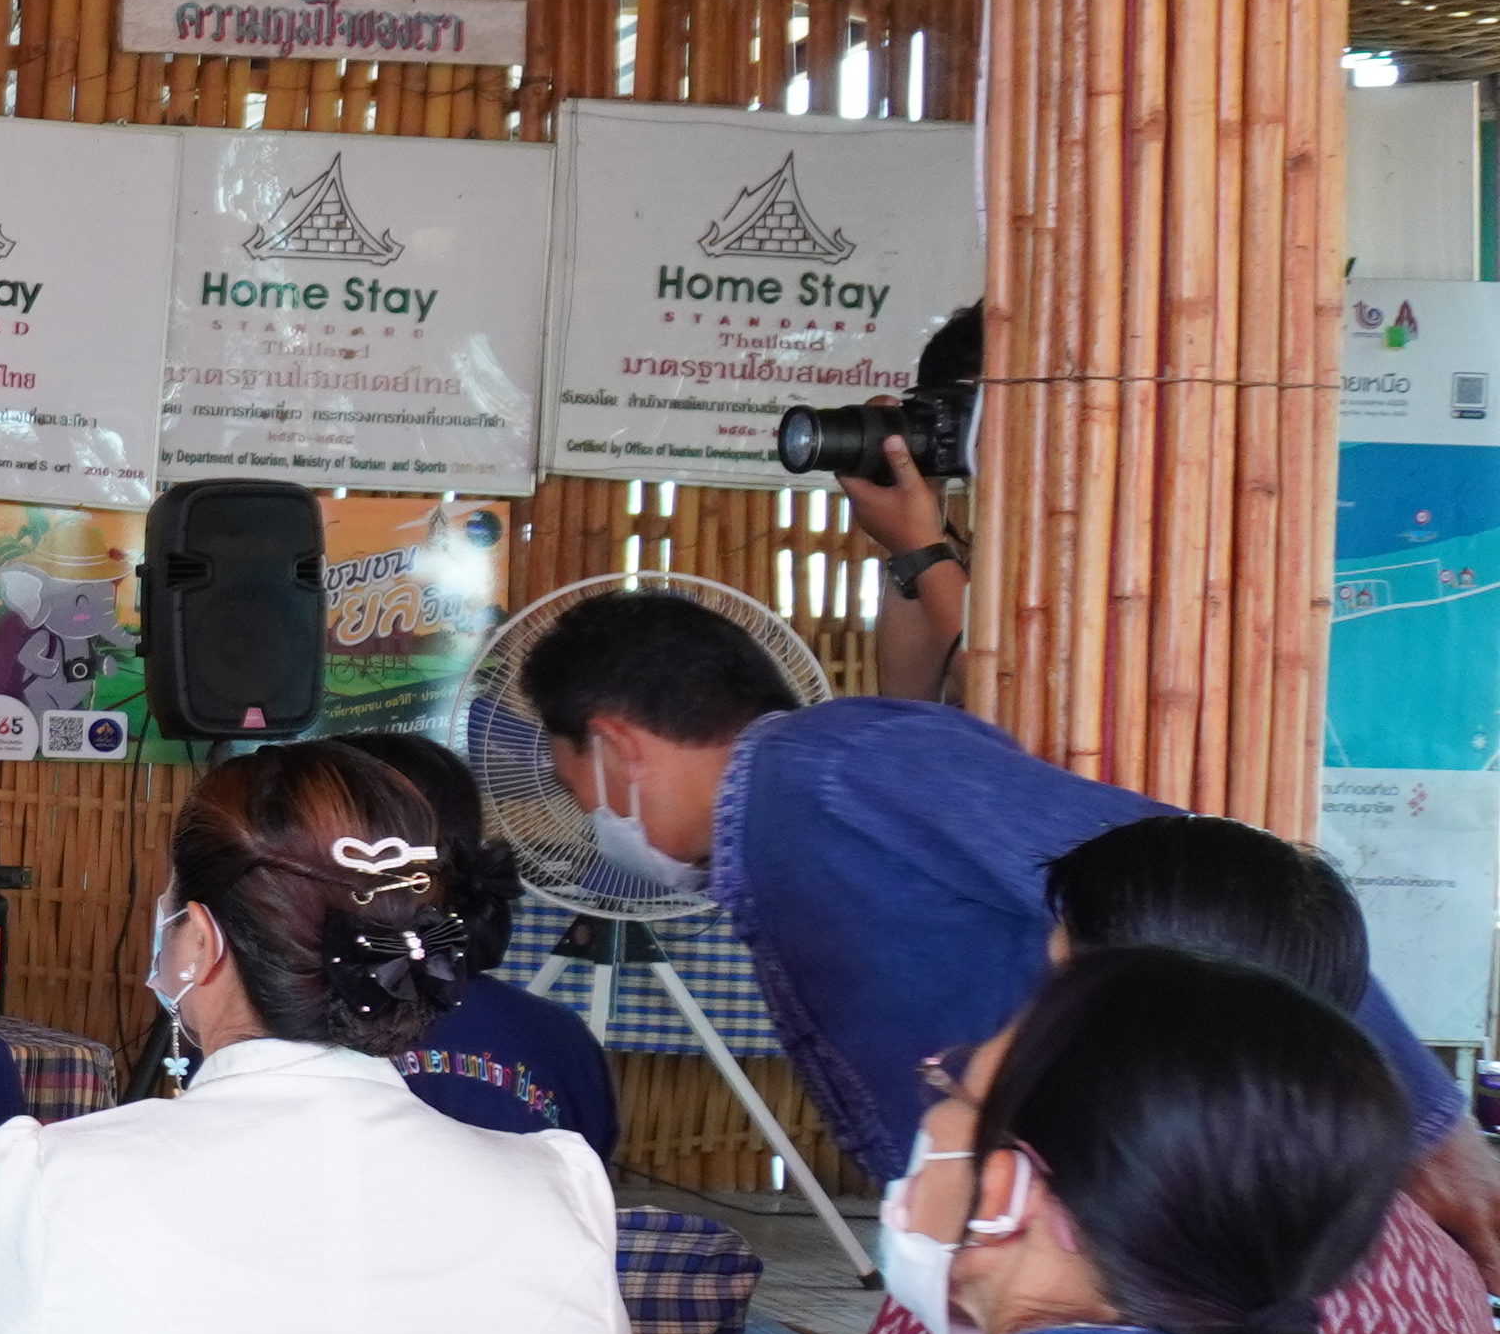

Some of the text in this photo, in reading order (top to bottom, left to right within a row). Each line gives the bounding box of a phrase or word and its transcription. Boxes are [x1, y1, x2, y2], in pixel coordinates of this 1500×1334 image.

[201, 271, 440, 323] Home Stay
[658, 265, 890, 318] Home Stay
[664, 311, 877, 333] STANDARD
[719, 332, 826, 352] Thailand
[161, 452, 174, 465] by
[177, 450, 235, 466] Department
[238, 452, 249, 465] of
[334, 456, 345, 469] of
[414, 458, 447, 474] Sports
